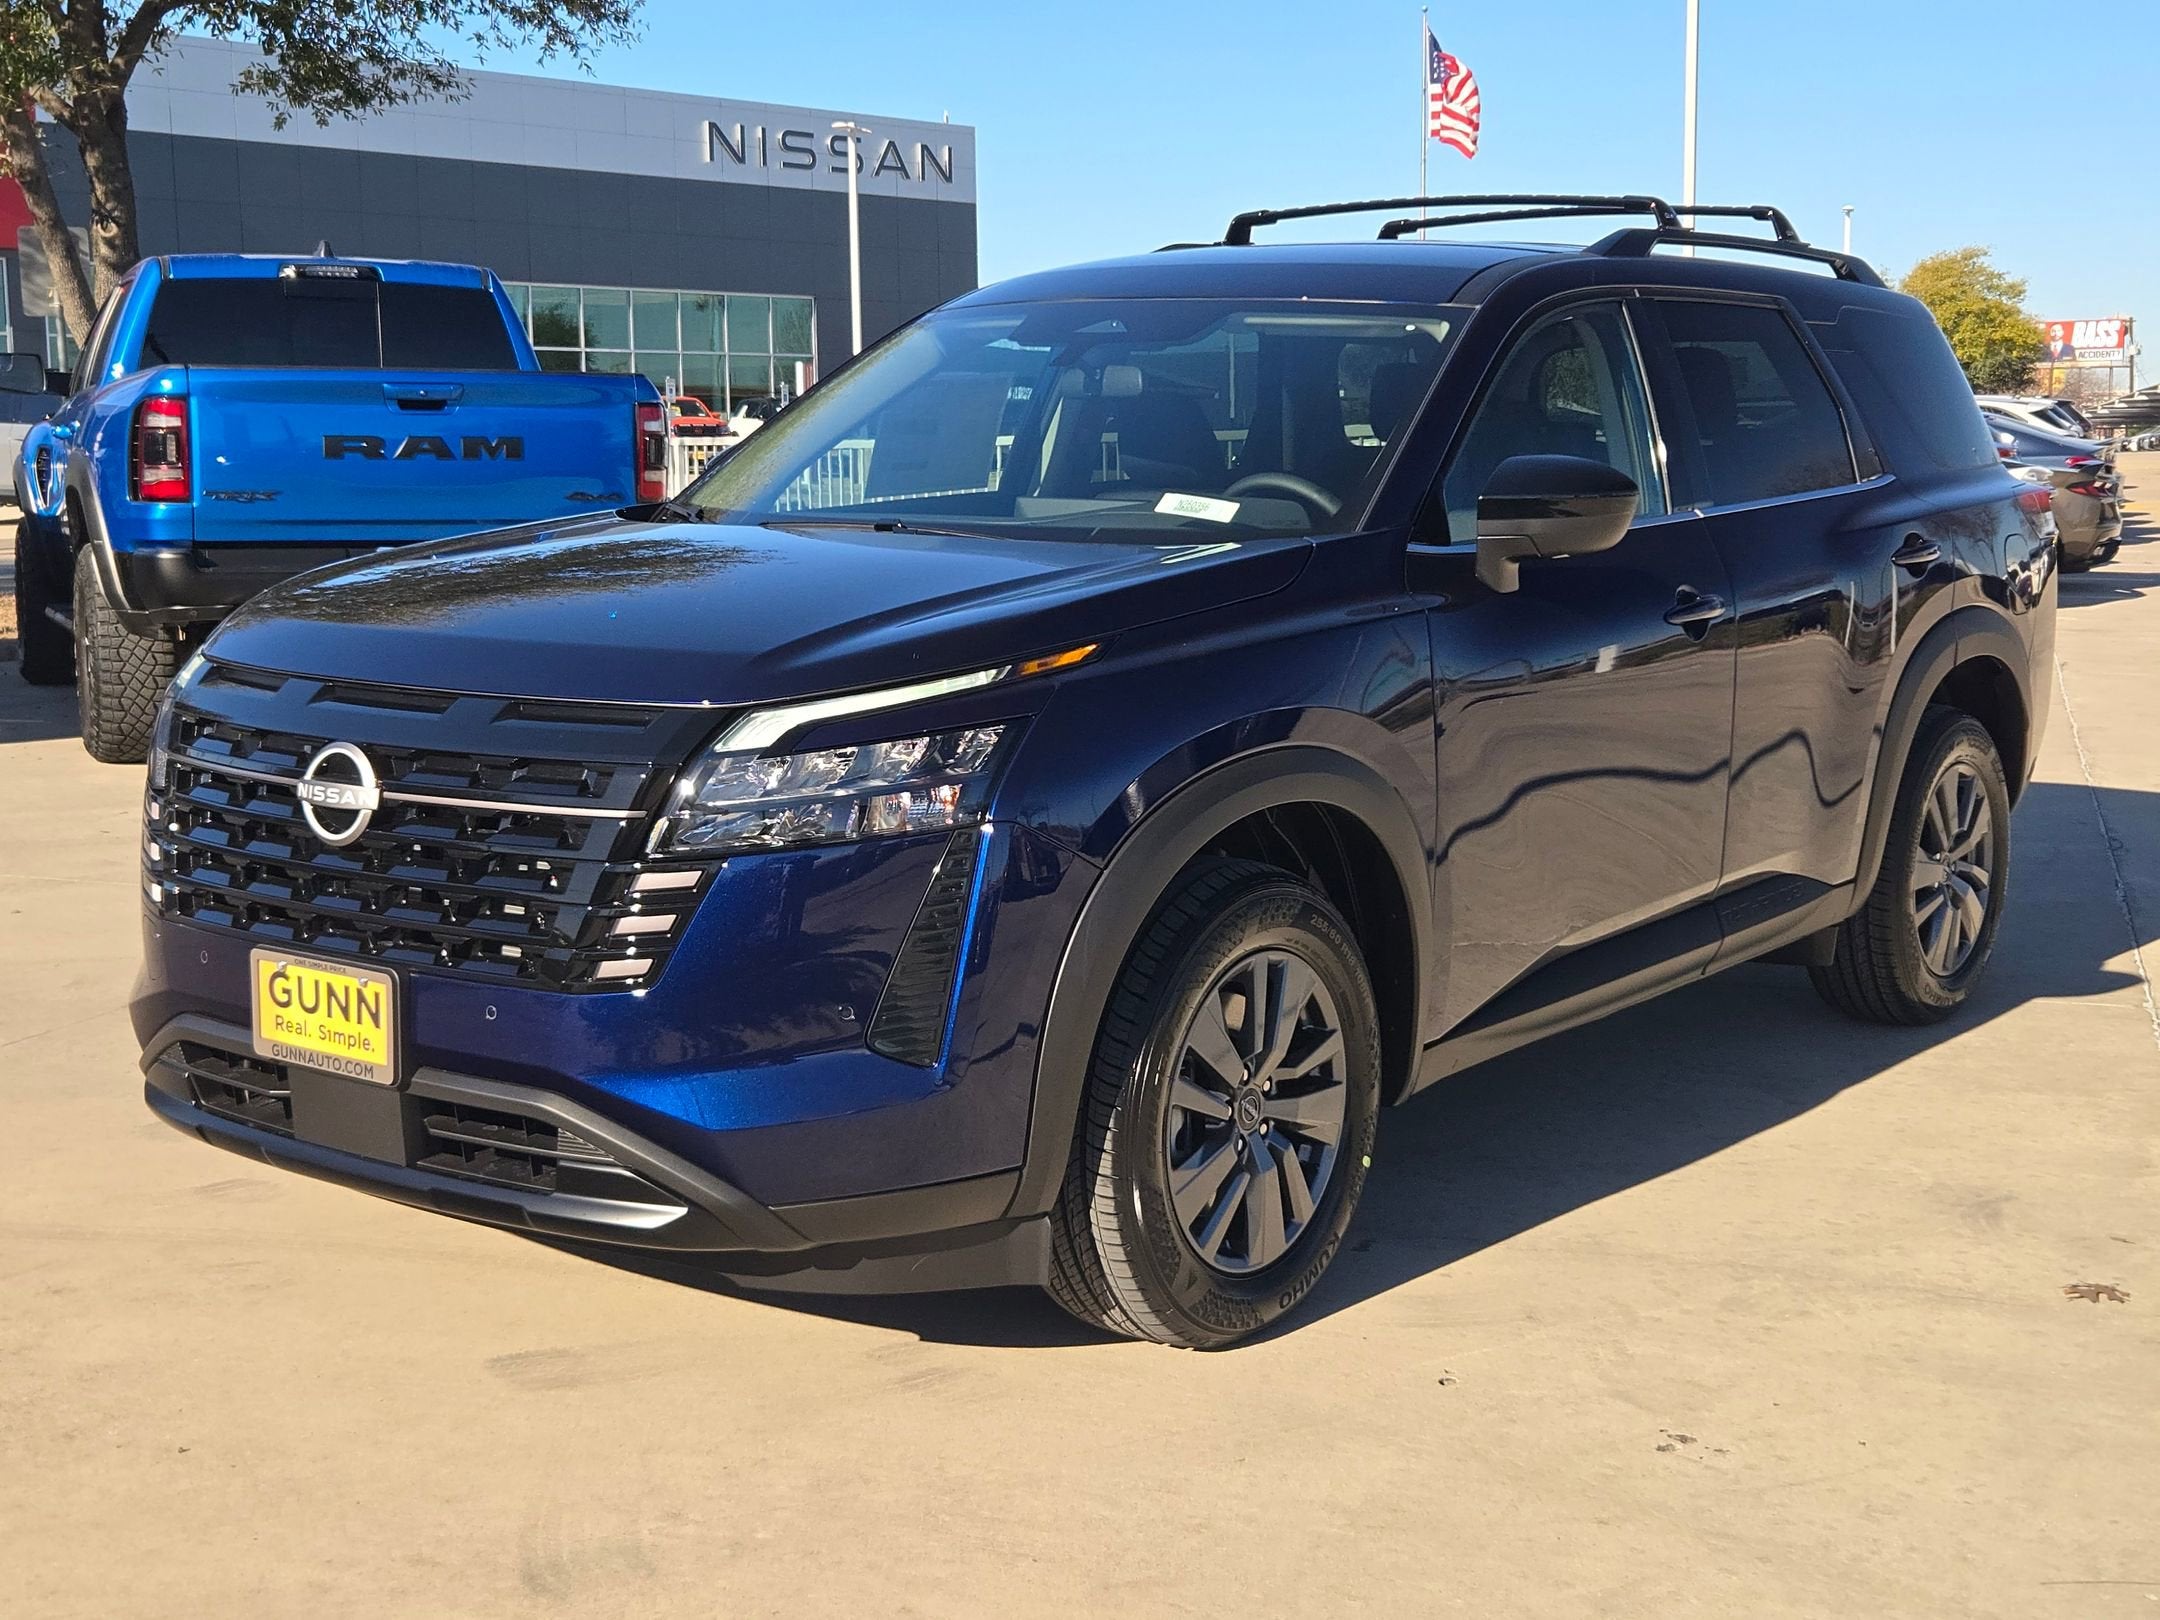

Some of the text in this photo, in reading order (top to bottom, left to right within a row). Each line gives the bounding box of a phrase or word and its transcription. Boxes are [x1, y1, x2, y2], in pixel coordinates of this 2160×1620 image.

[705, 120, 953, 184] NISSAN
[2078, 350, 2121, 359] ACCIDENT?
[322, 435, 524, 461] RAM
[298, 782, 376, 806] NISSAN
[1311, 914, 1341, 944] 255/60
[269, 970, 381, 1029] GUNN
[275, 1015, 375, 1053] Real. Simple.
[272, 1043, 374, 1080] GUNNAUTO.COM
[1279, 1231, 1339, 1309] KUMHO
